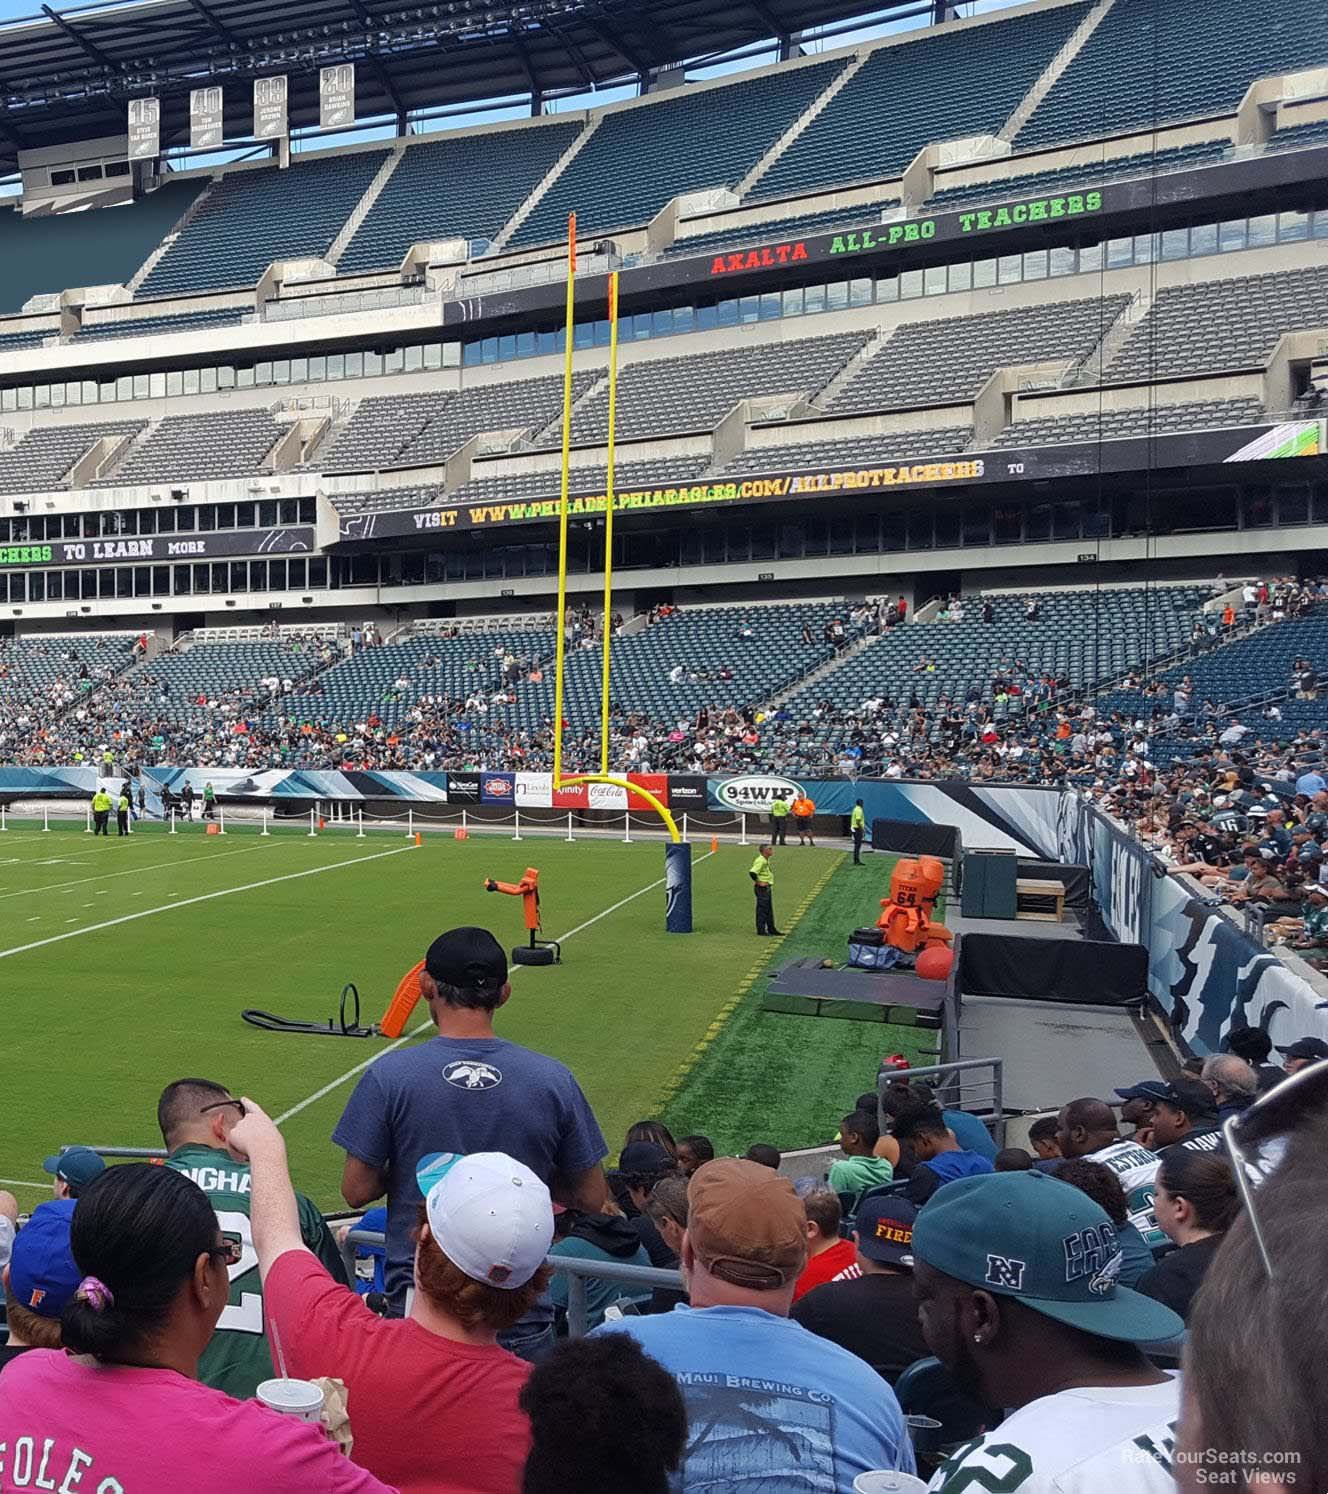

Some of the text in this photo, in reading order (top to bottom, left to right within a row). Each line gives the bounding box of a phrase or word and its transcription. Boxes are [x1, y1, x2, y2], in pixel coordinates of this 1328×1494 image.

[256, 78, 286, 105] 99
[322, 66, 352, 95] 20
[131, 100, 156, 126] 15
[192, 88, 220, 116] 40
[711, 191, 1103, 274] AXALTA ALL-PRO TEACHERS
[413, 510, 457, 529] VISIT
[1008, 463, 1024, 475] TO
[63, 545, 85, 560] TO
[93, 540, 153, 558] LEARN
[168, 541, 205, 554] MORE
[727, 786, 794, 801] 94WIP
[29, 1288, 47, 1308] F
[726, 1375, 802, 1396] BREWING
